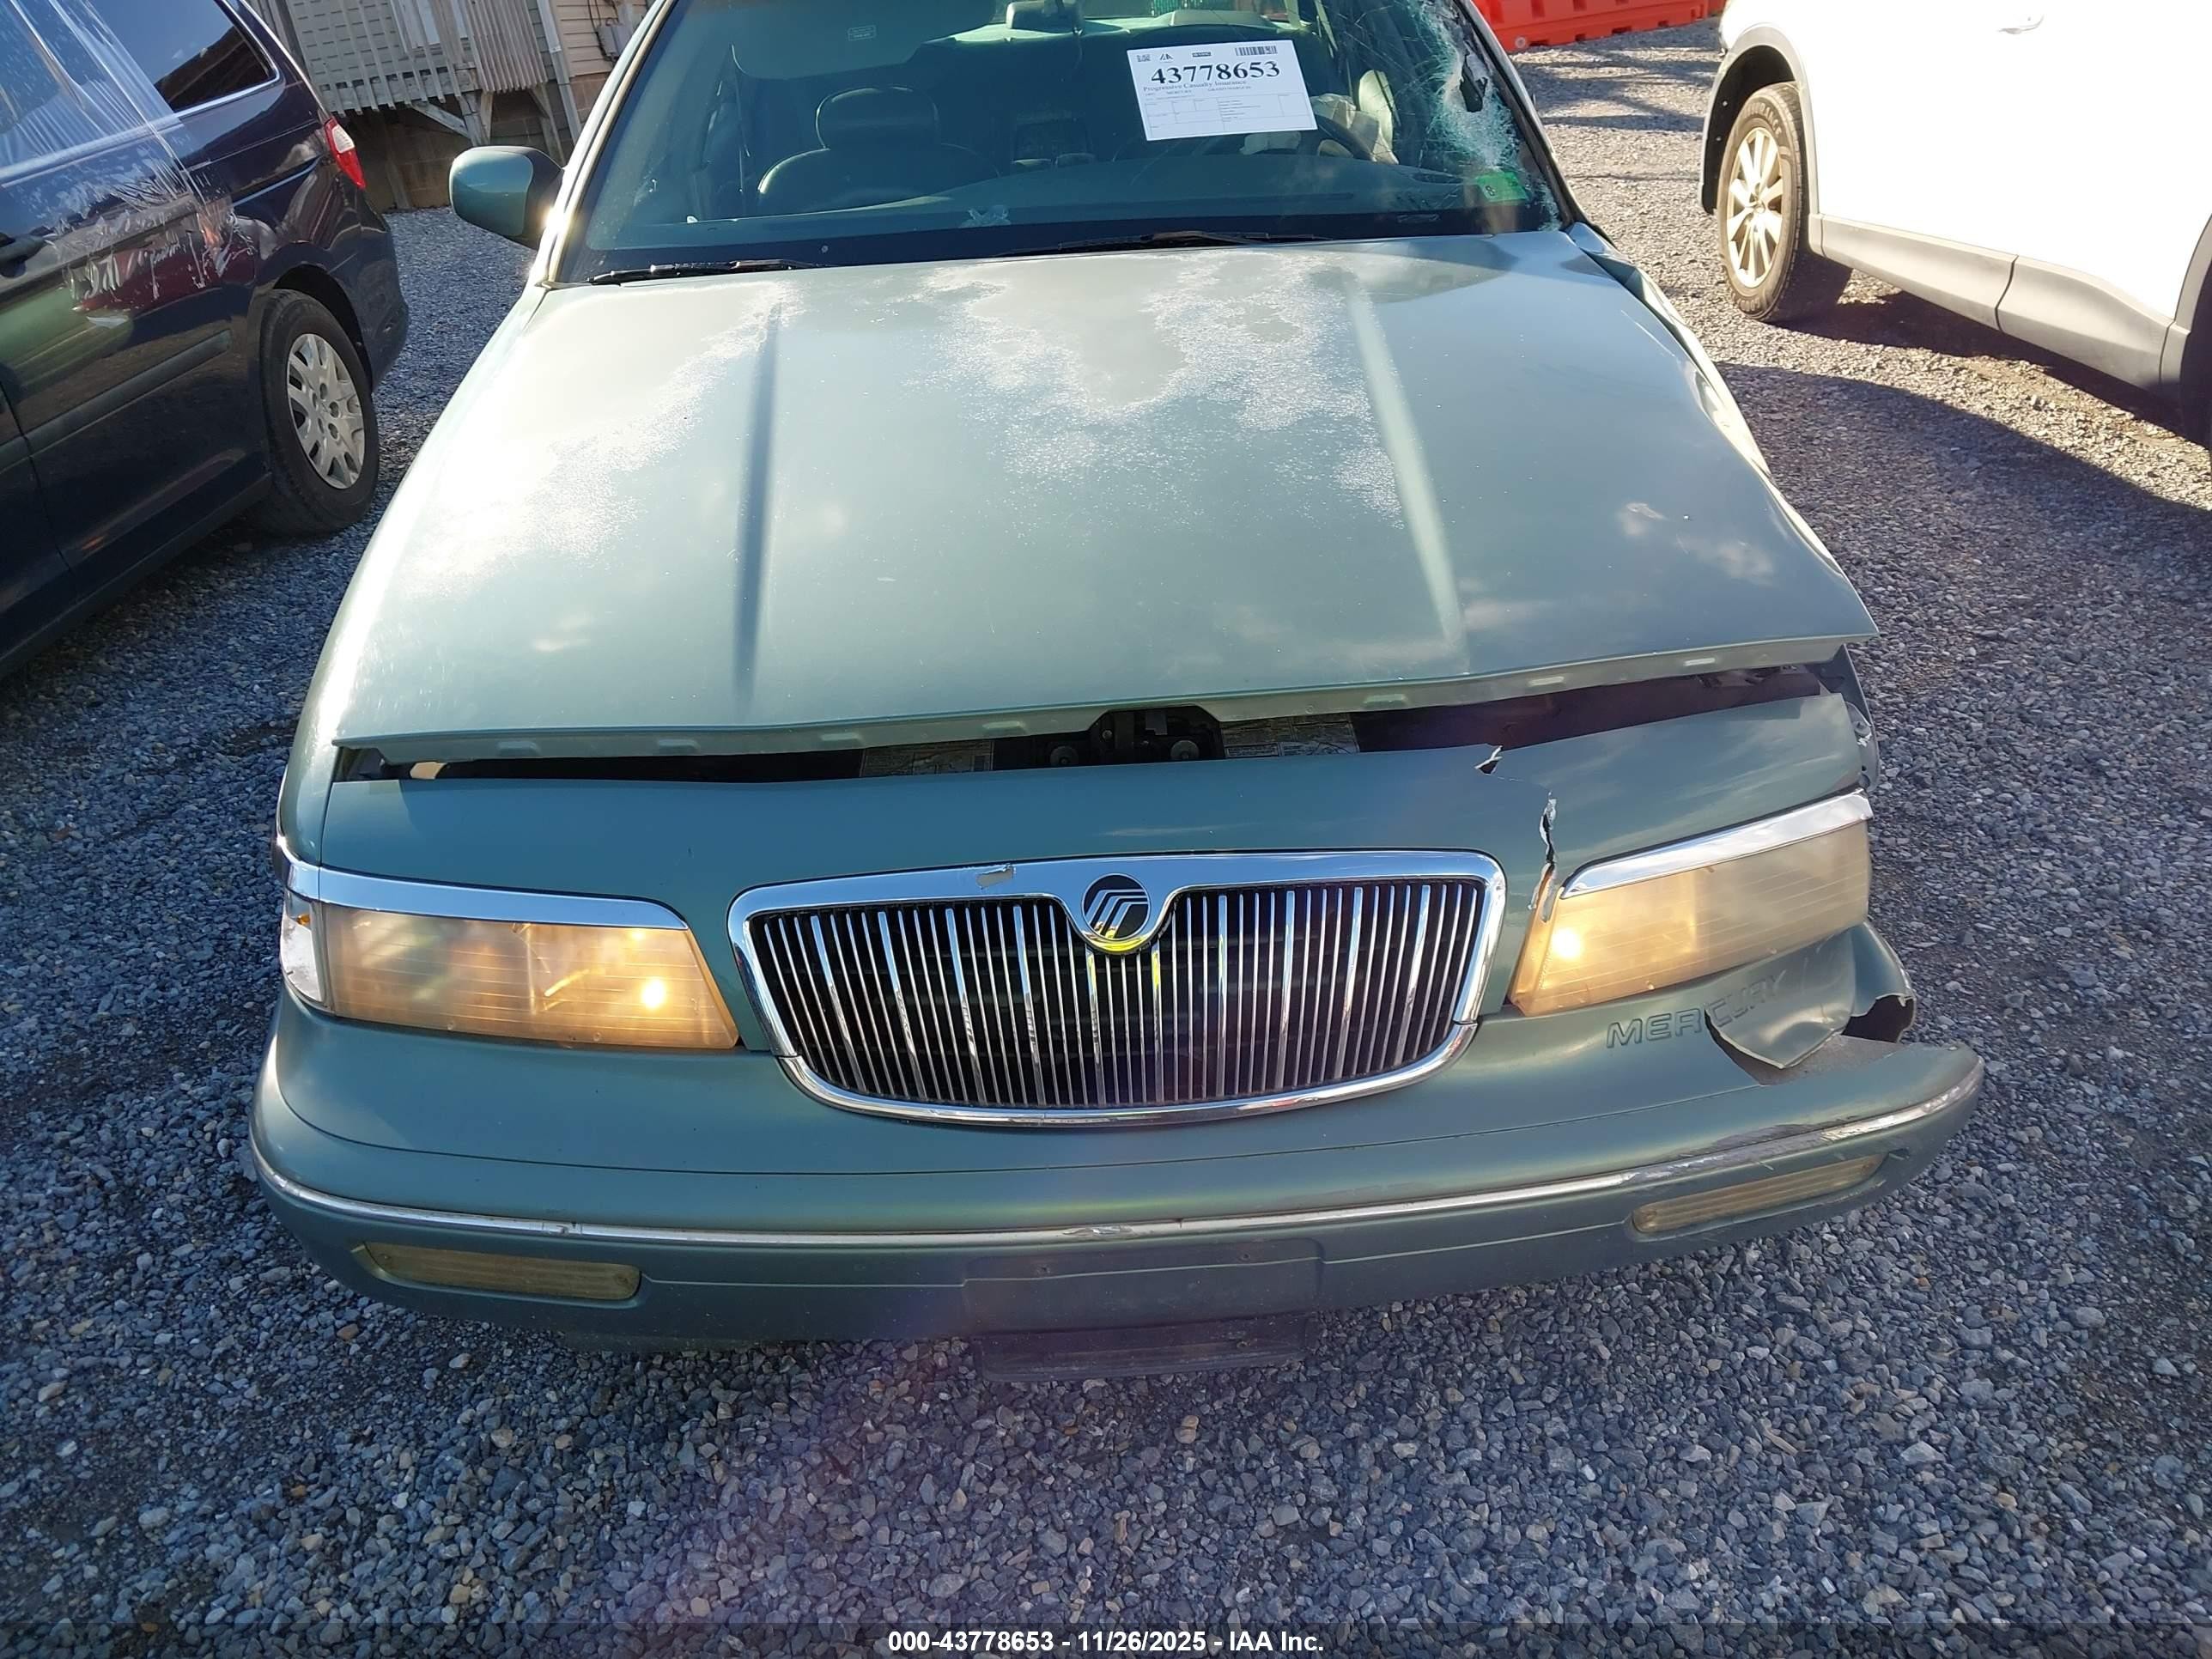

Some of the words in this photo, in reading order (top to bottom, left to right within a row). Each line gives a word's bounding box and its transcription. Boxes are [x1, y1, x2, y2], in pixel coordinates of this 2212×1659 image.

[1151, 60, 1280, 84] 43778653
[1143, 84, 1183, 93] Progressive
[1183, 81, 1213, 89] Casualty
[1606, 969, 1786, 1048] MERCURY
